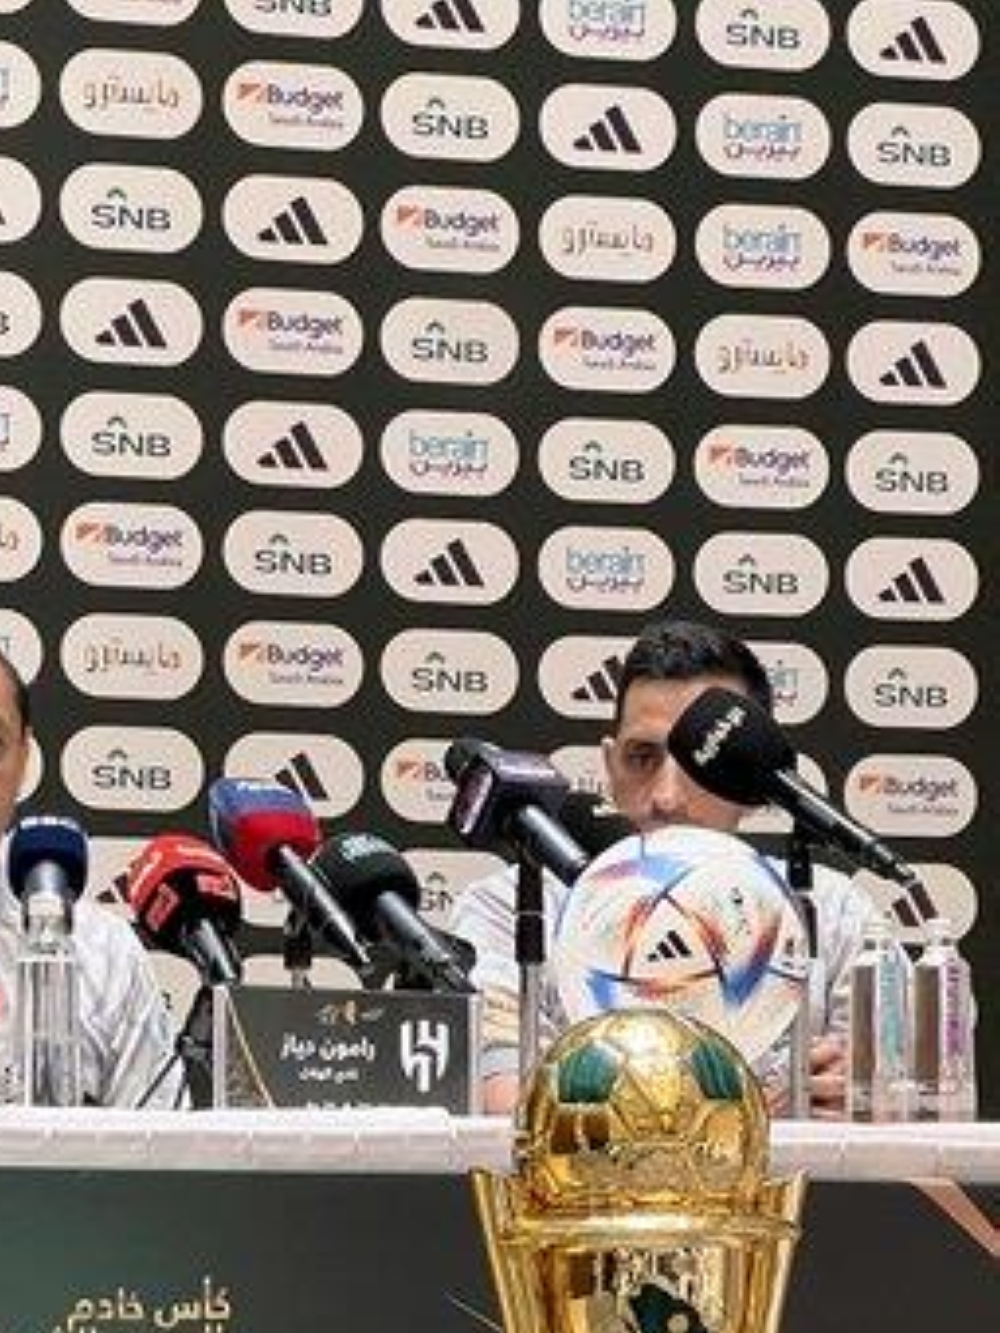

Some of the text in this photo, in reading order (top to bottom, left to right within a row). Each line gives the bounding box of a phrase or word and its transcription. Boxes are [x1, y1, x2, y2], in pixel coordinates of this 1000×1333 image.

[726, 23, 801, 50] SNB
[267, 83, 343, 115] Budget
[412, 112, 489, 140] SNB
[724, 114, 804, 142] berain
[876, 140, 953, 167] SNB
[91, 203, 171, 232] SNB
[424, 208, 502, 238] Budget
[723, 224, 801, 252] berain
[889, 233, 964, 261] Budget
[267, 310, 346, 341] Budget
[411, 336, 488, 364] SNB
[582, 329, 656, 359] Budget
[91, 430, 173, 458] SNB
[410, 430, 488, 459] berain
[569, 456, 647, 483] SNB
[737, 447, 812, 477] Budget
[875, 468, 950, 495] SNB
[105, 524, 183, 554] Budget
[254, 548, 332, 576] SNB
[567, 546, 645, 574] berain
[723, 570, 800, 595] SNB
[267, 643, 345, 672] Budget
[411, 667, 488, 693] SNB
[873, 681, 949, 708] SNB
[91, 765, 172, 792] SNB
[886, 776, 958, 802] Budget
[67, 1276, 231, 1332] كأس خادم
